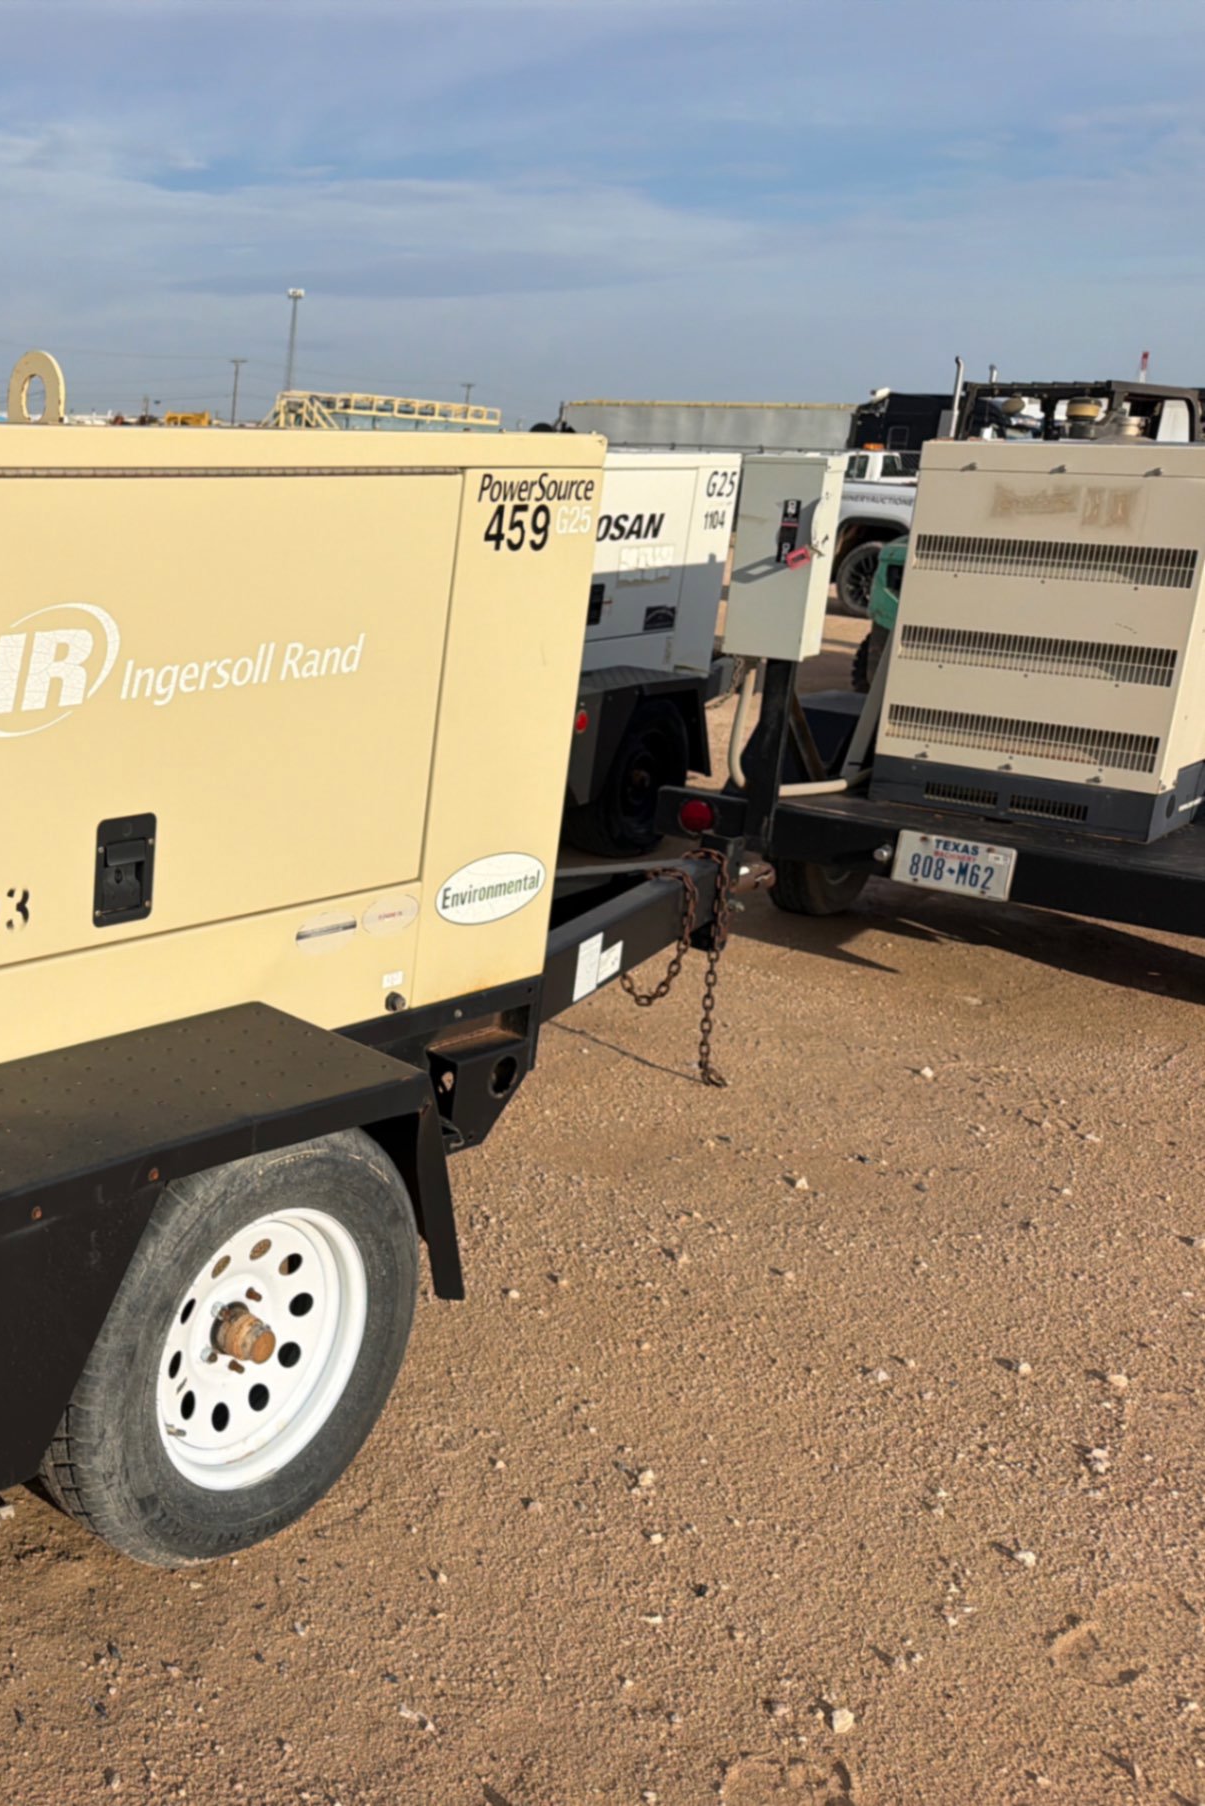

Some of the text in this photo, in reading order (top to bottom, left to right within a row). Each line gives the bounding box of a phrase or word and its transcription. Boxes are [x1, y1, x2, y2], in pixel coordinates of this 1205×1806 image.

[477, 473, 595, 502] PowerSource
[706, 470, 737, 498] G25
[483, 504, 551, 551] 459
[555, 506, 592, 535] G25
[703, 510, 726, 530] 1104
[120, 642, 276, 707] Ingersoll
[280, 632, 366, 682] Rand
[934, 839, 979, 856] TEXAS
[441, 869, 541, 910] Environmental
